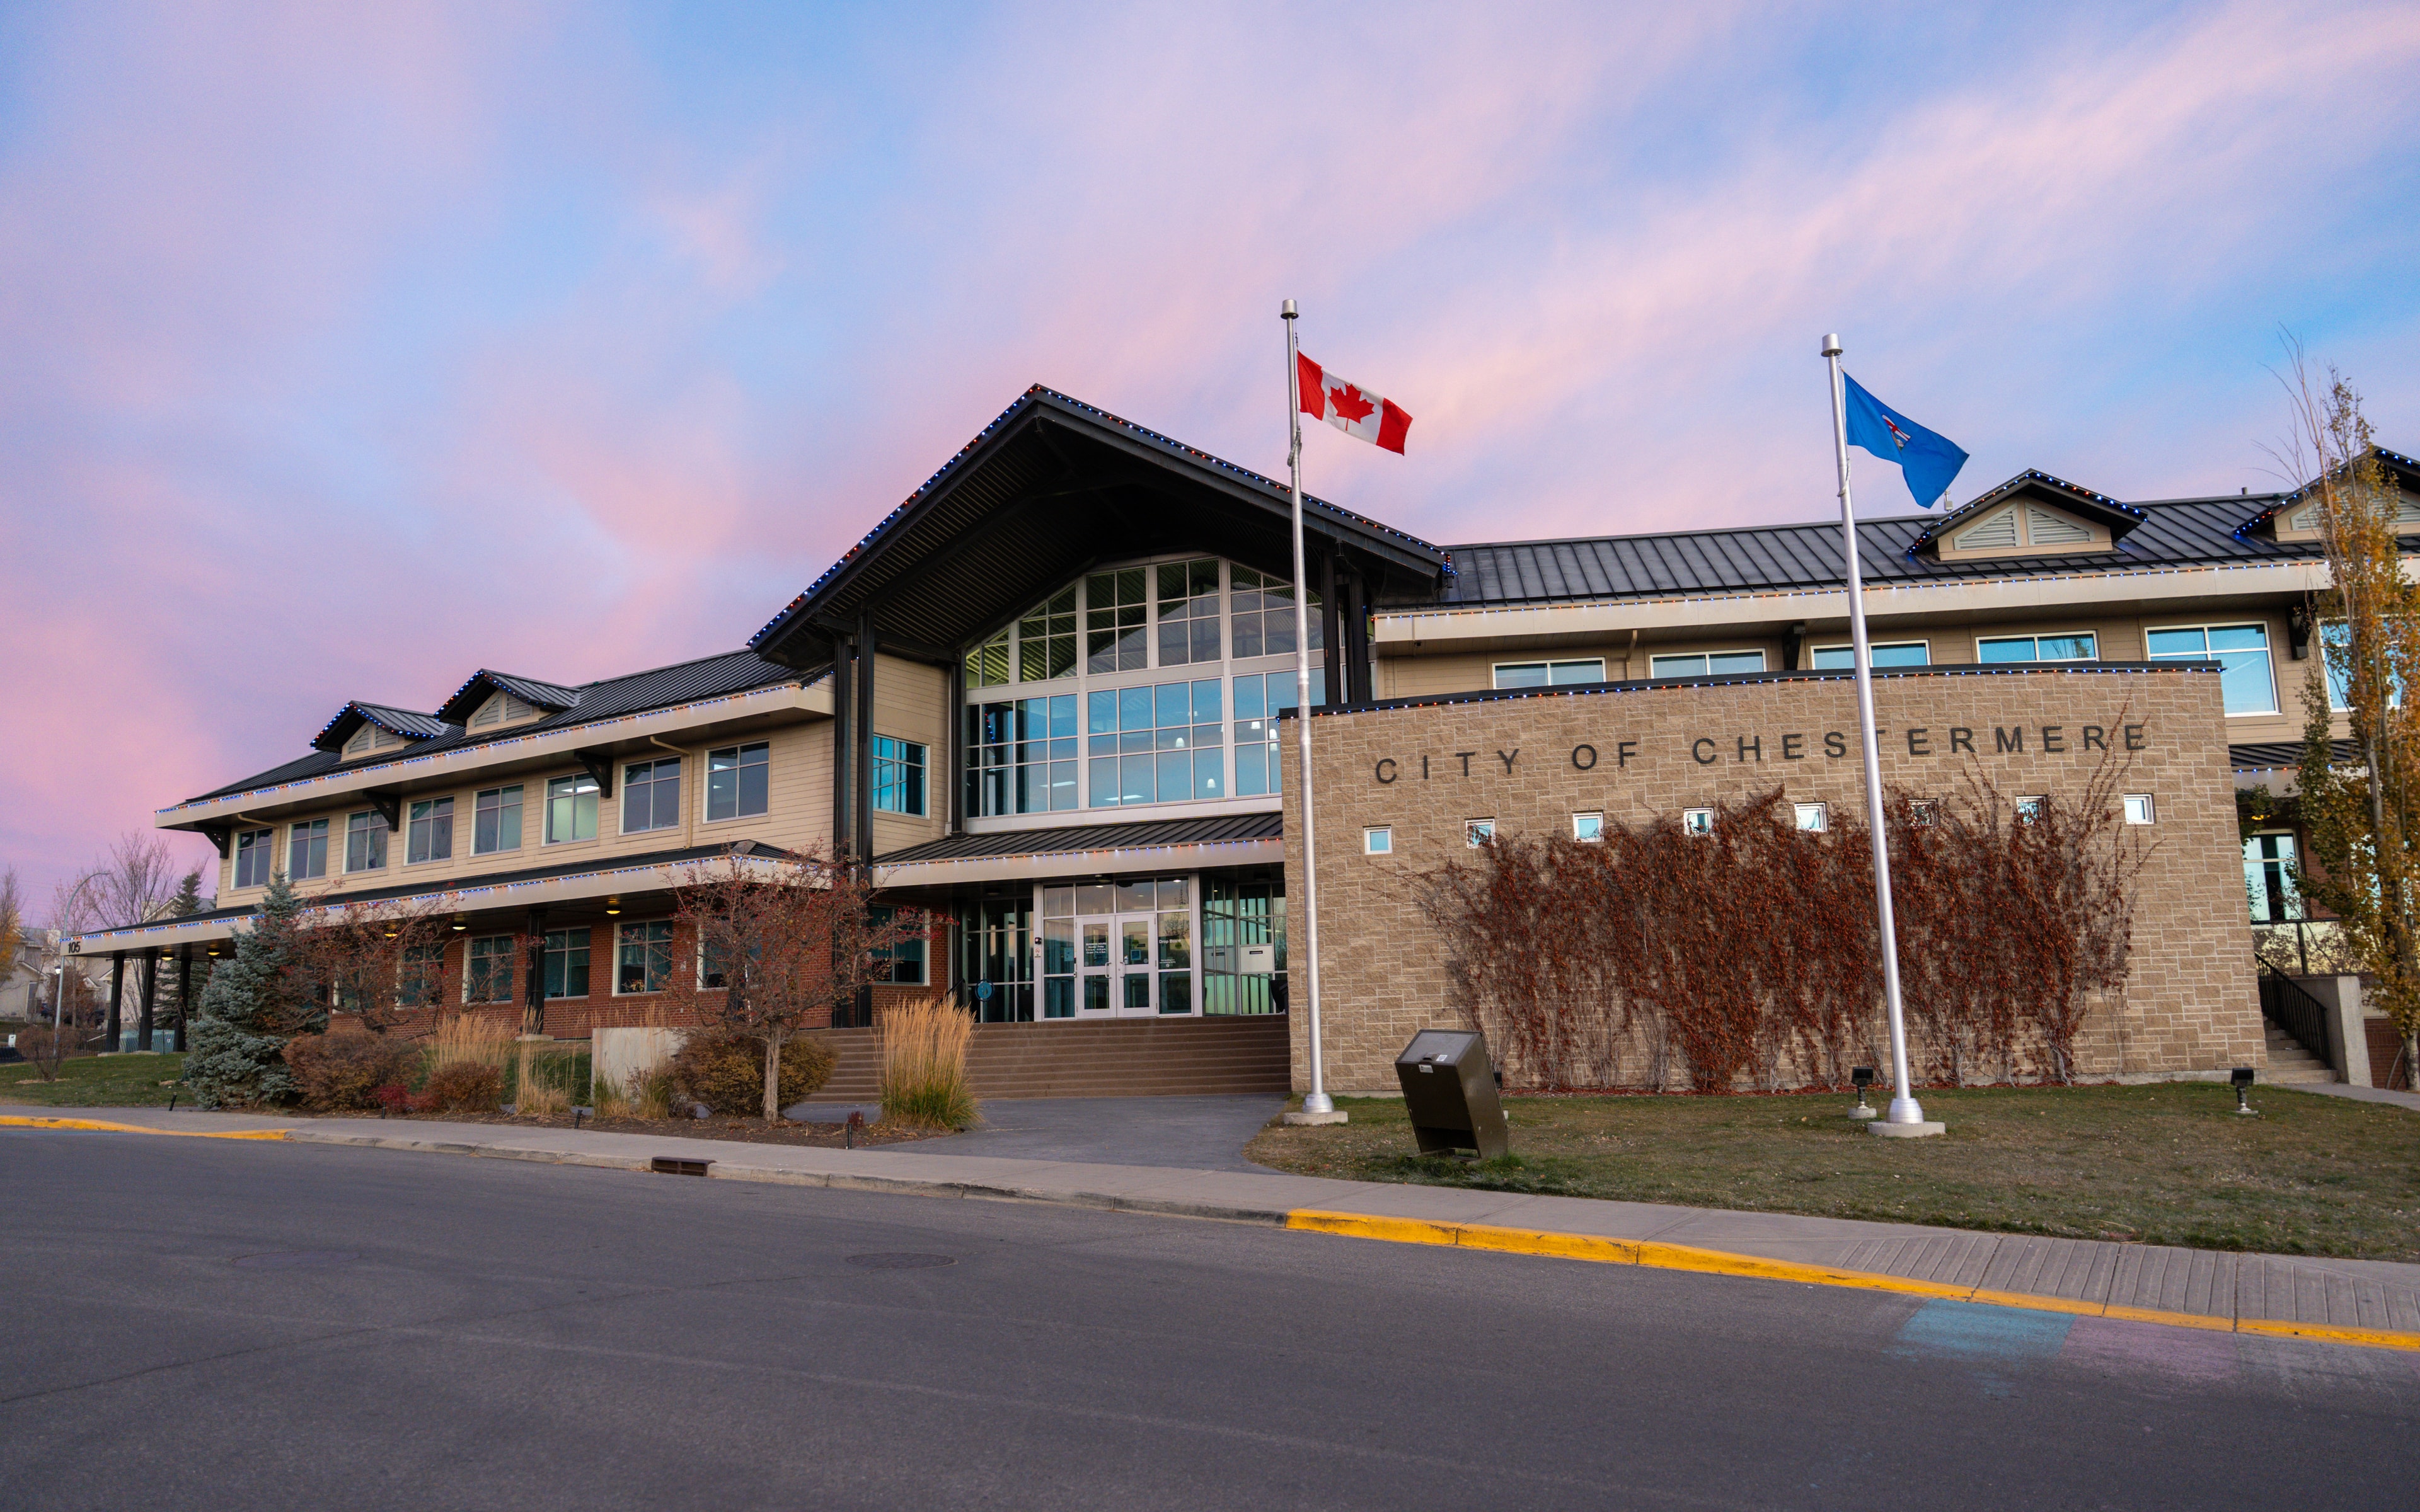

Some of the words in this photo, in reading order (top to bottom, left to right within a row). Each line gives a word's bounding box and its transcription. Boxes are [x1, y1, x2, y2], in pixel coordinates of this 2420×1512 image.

[1375, 748, 1519, 784] CITY
[1572, 741, 1637, 770] OF
[67, 941, 81, 953] 105
